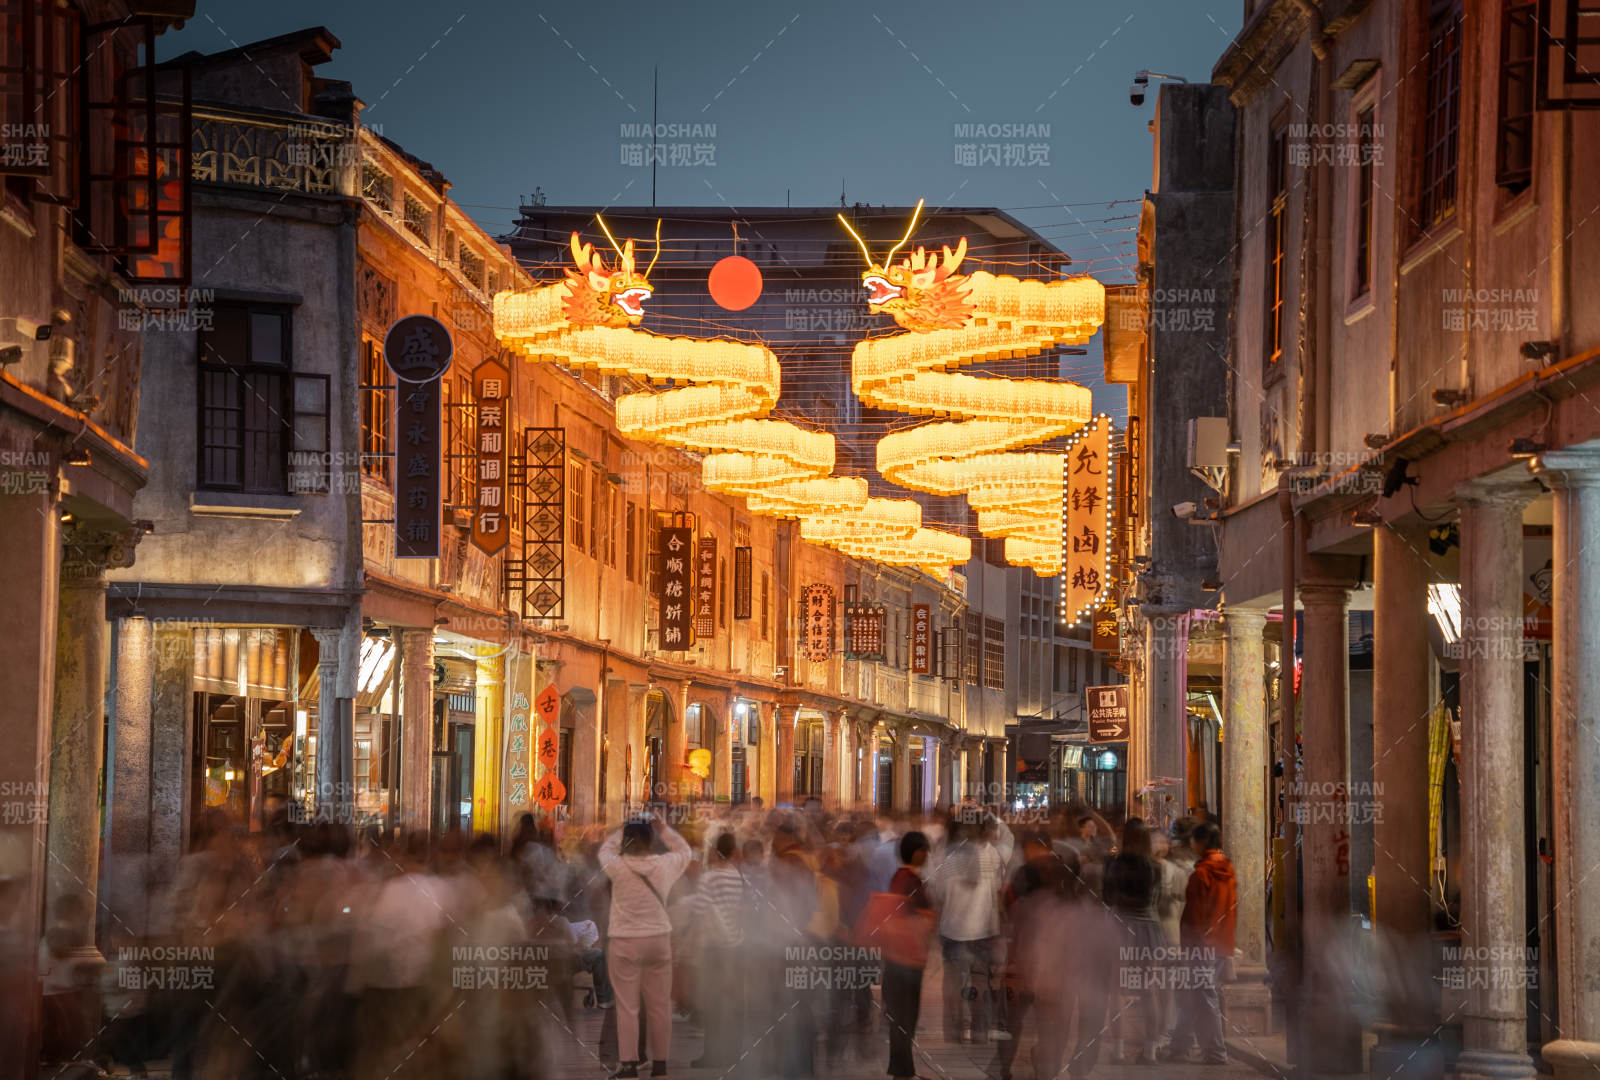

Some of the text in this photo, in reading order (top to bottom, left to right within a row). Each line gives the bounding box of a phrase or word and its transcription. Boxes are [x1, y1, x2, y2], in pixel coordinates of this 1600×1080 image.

[401, 326, 438, 371] 盛
[1071, 445, 1103, 595] 允锋卤鹅
